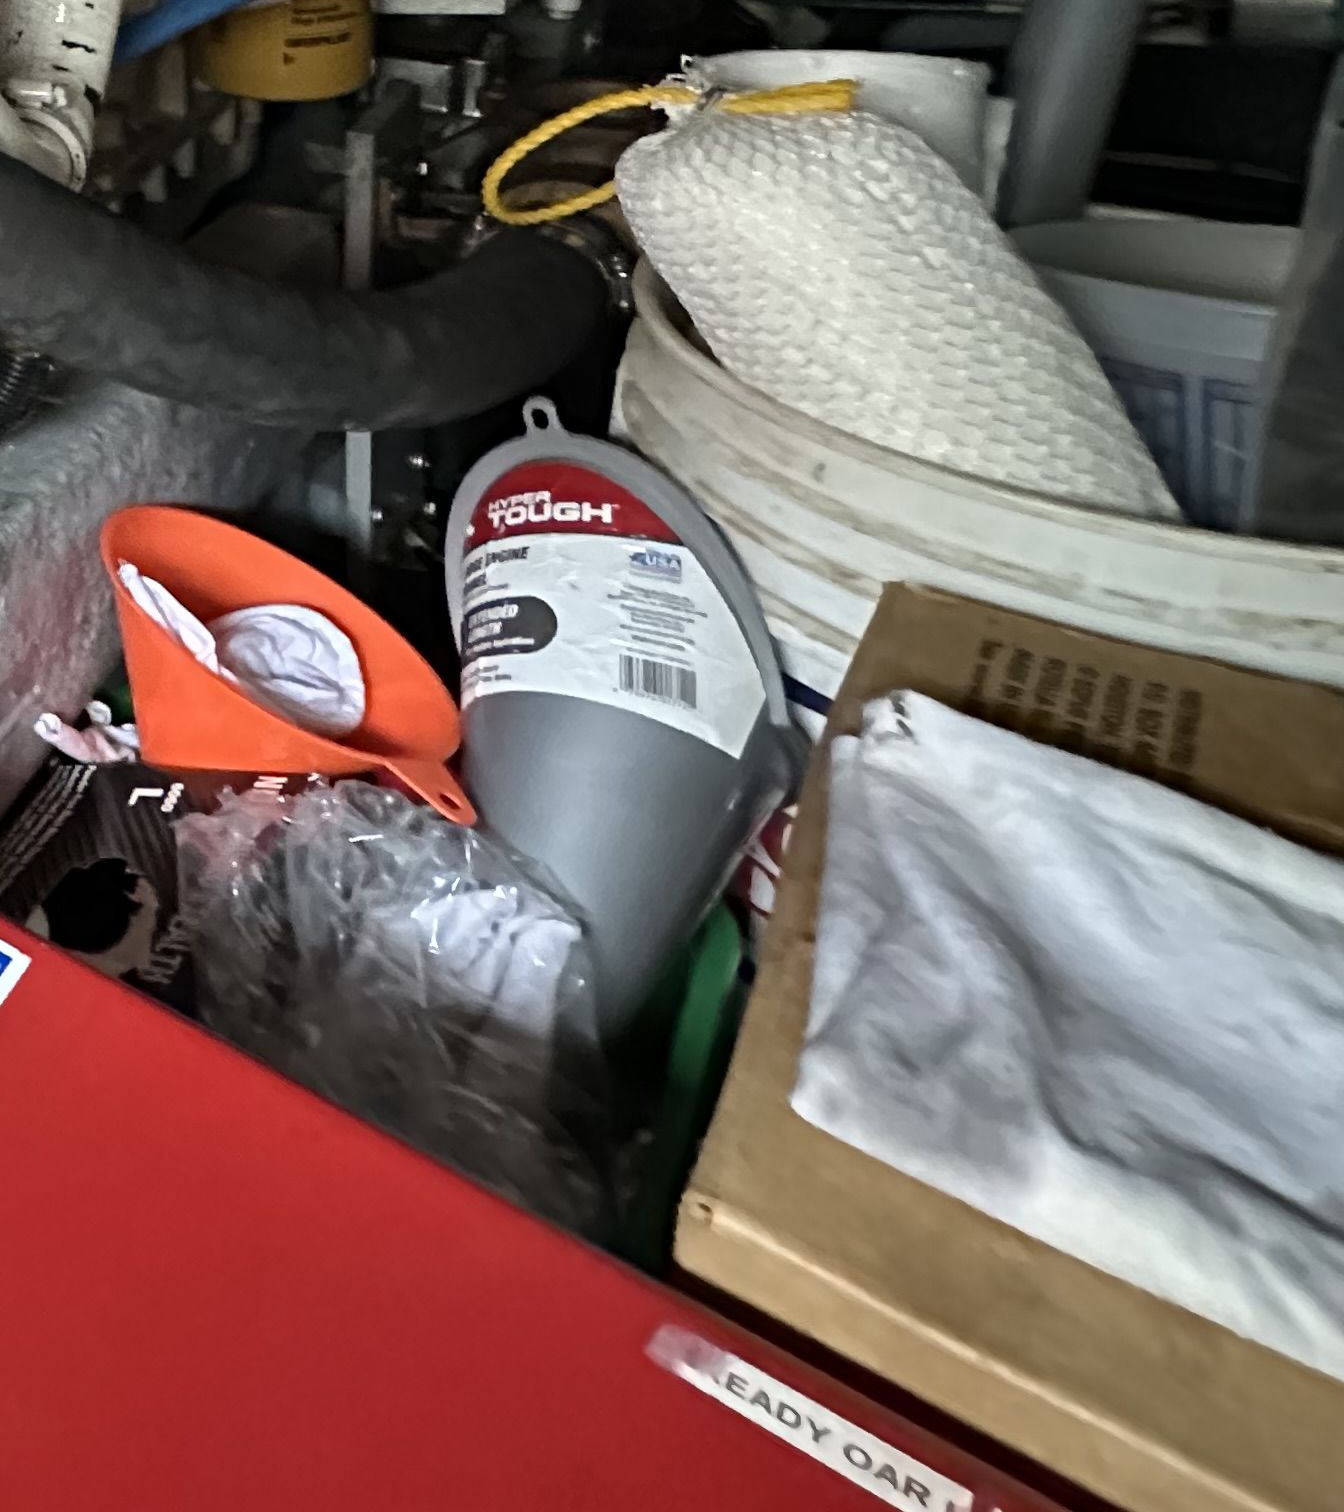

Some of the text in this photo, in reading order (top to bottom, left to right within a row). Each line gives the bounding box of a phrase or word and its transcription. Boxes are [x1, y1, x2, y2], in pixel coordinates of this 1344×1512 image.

[488, 490, 551, 513] HYPER
[488, 501, 612, 528] TOUGH
[711, 1371, 932, 1509] EADY OAR
